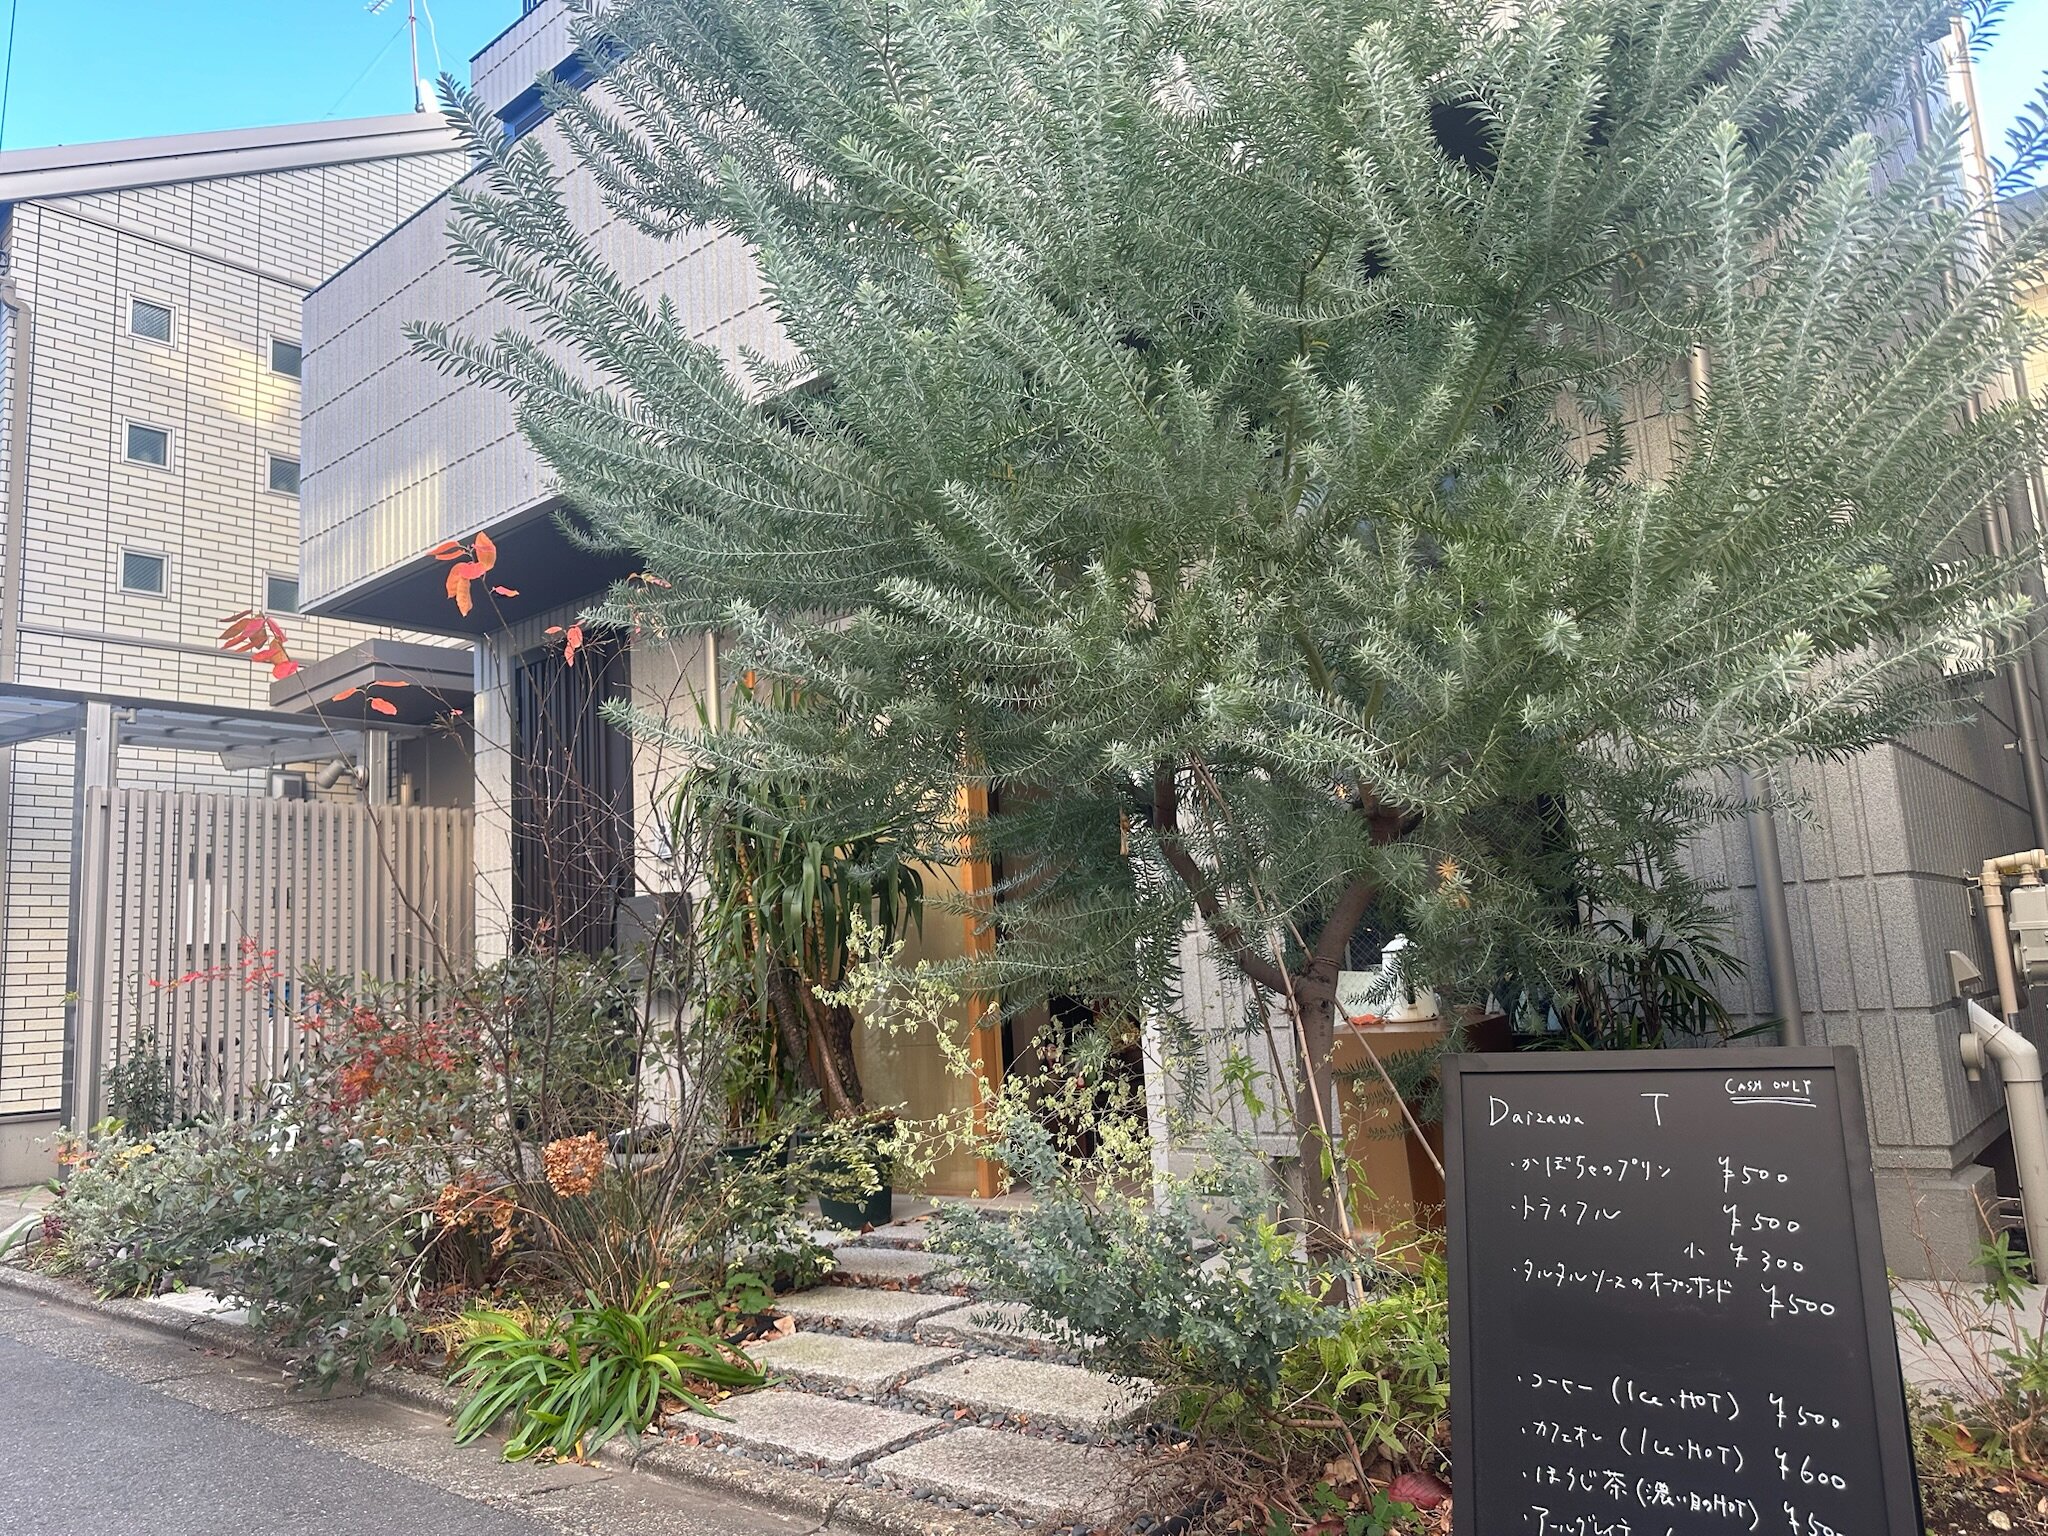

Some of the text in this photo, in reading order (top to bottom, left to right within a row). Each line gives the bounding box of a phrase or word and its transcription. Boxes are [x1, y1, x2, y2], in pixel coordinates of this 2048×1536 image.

[1724, 1077, 1812, 1096] CASH ONLY
[1489, 1092, 1670, 1127] Daizawa T
[1683, 1241, 1705, 1259] 小
[1783, 1500, 1844, 1536] ¥50
